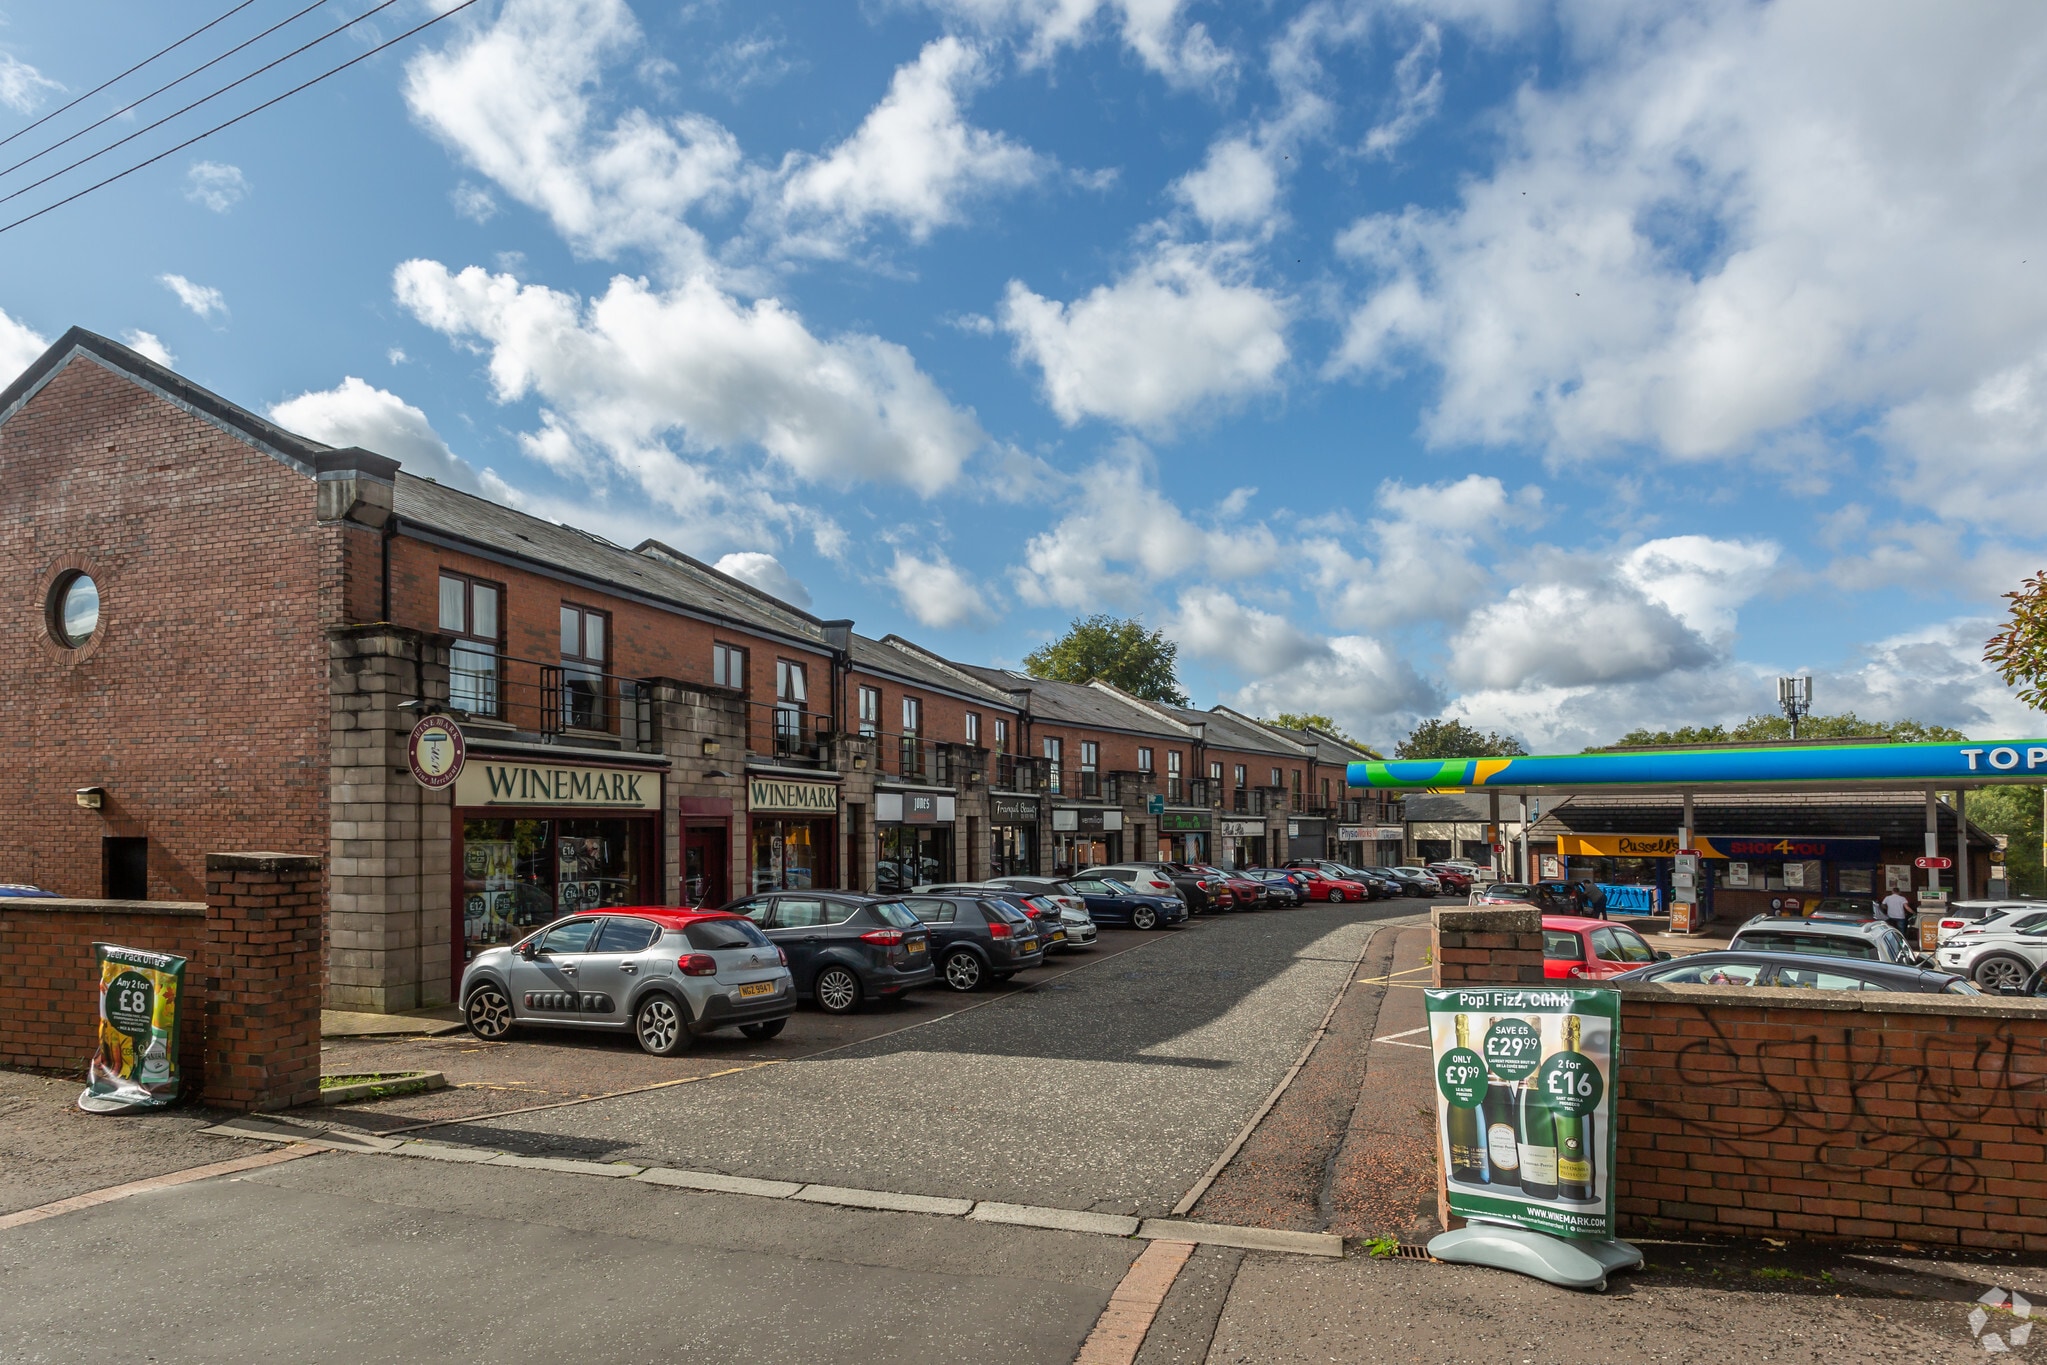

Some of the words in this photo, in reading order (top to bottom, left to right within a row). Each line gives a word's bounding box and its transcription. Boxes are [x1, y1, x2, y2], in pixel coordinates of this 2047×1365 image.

[414, 718, 460, 740] WINEMARK
[1960, 747, 2047, 770] TOP
[413, 766, 429, 783] Wine
[430, 765, 458, 785] Merchant
[485, 766, 643, 801] WINEMARK
[751, 782, 836, 808] WINEMARK
[995, 800, 1020, 819] Tranquil
[1020, 802, 1038, 818] Beauty
[1694, 850, 1700, 858] 3
[1918, 859, 1926, 867] 2
[1941, 859, 1947, 867] 1
[469, 902, 483, 912] £12
[1672, 914, 1688, 922] 3%
[116, 978, 131, 989] Any
[131, 980, 136, 988] 2
[137, 981, 149, 990] for
[741, 986, 756, 996] NGZ
[755, 983, 772, 994] 9947
[118, 990, 146, 1013] £8
[1459, 993, 1490, 1008] Pop!
[1493, 993, 1527, 1009] Fizz,
[1530, 992, 1570, 1008] Clink
[1495, 1026, 1517, 1035] SAVE
[1518, 1026, 1529, 1035] £5
[1452, 1055, 1472, 1064] ONLY
[1557, 1059, 1564, 1069] 2
[1565, 1059, 1582, 1070] for
[1547, 1070, 1593, 1097] £16
[1526, 1206, 1606, 1228] WWW.WINEMARK.COM
